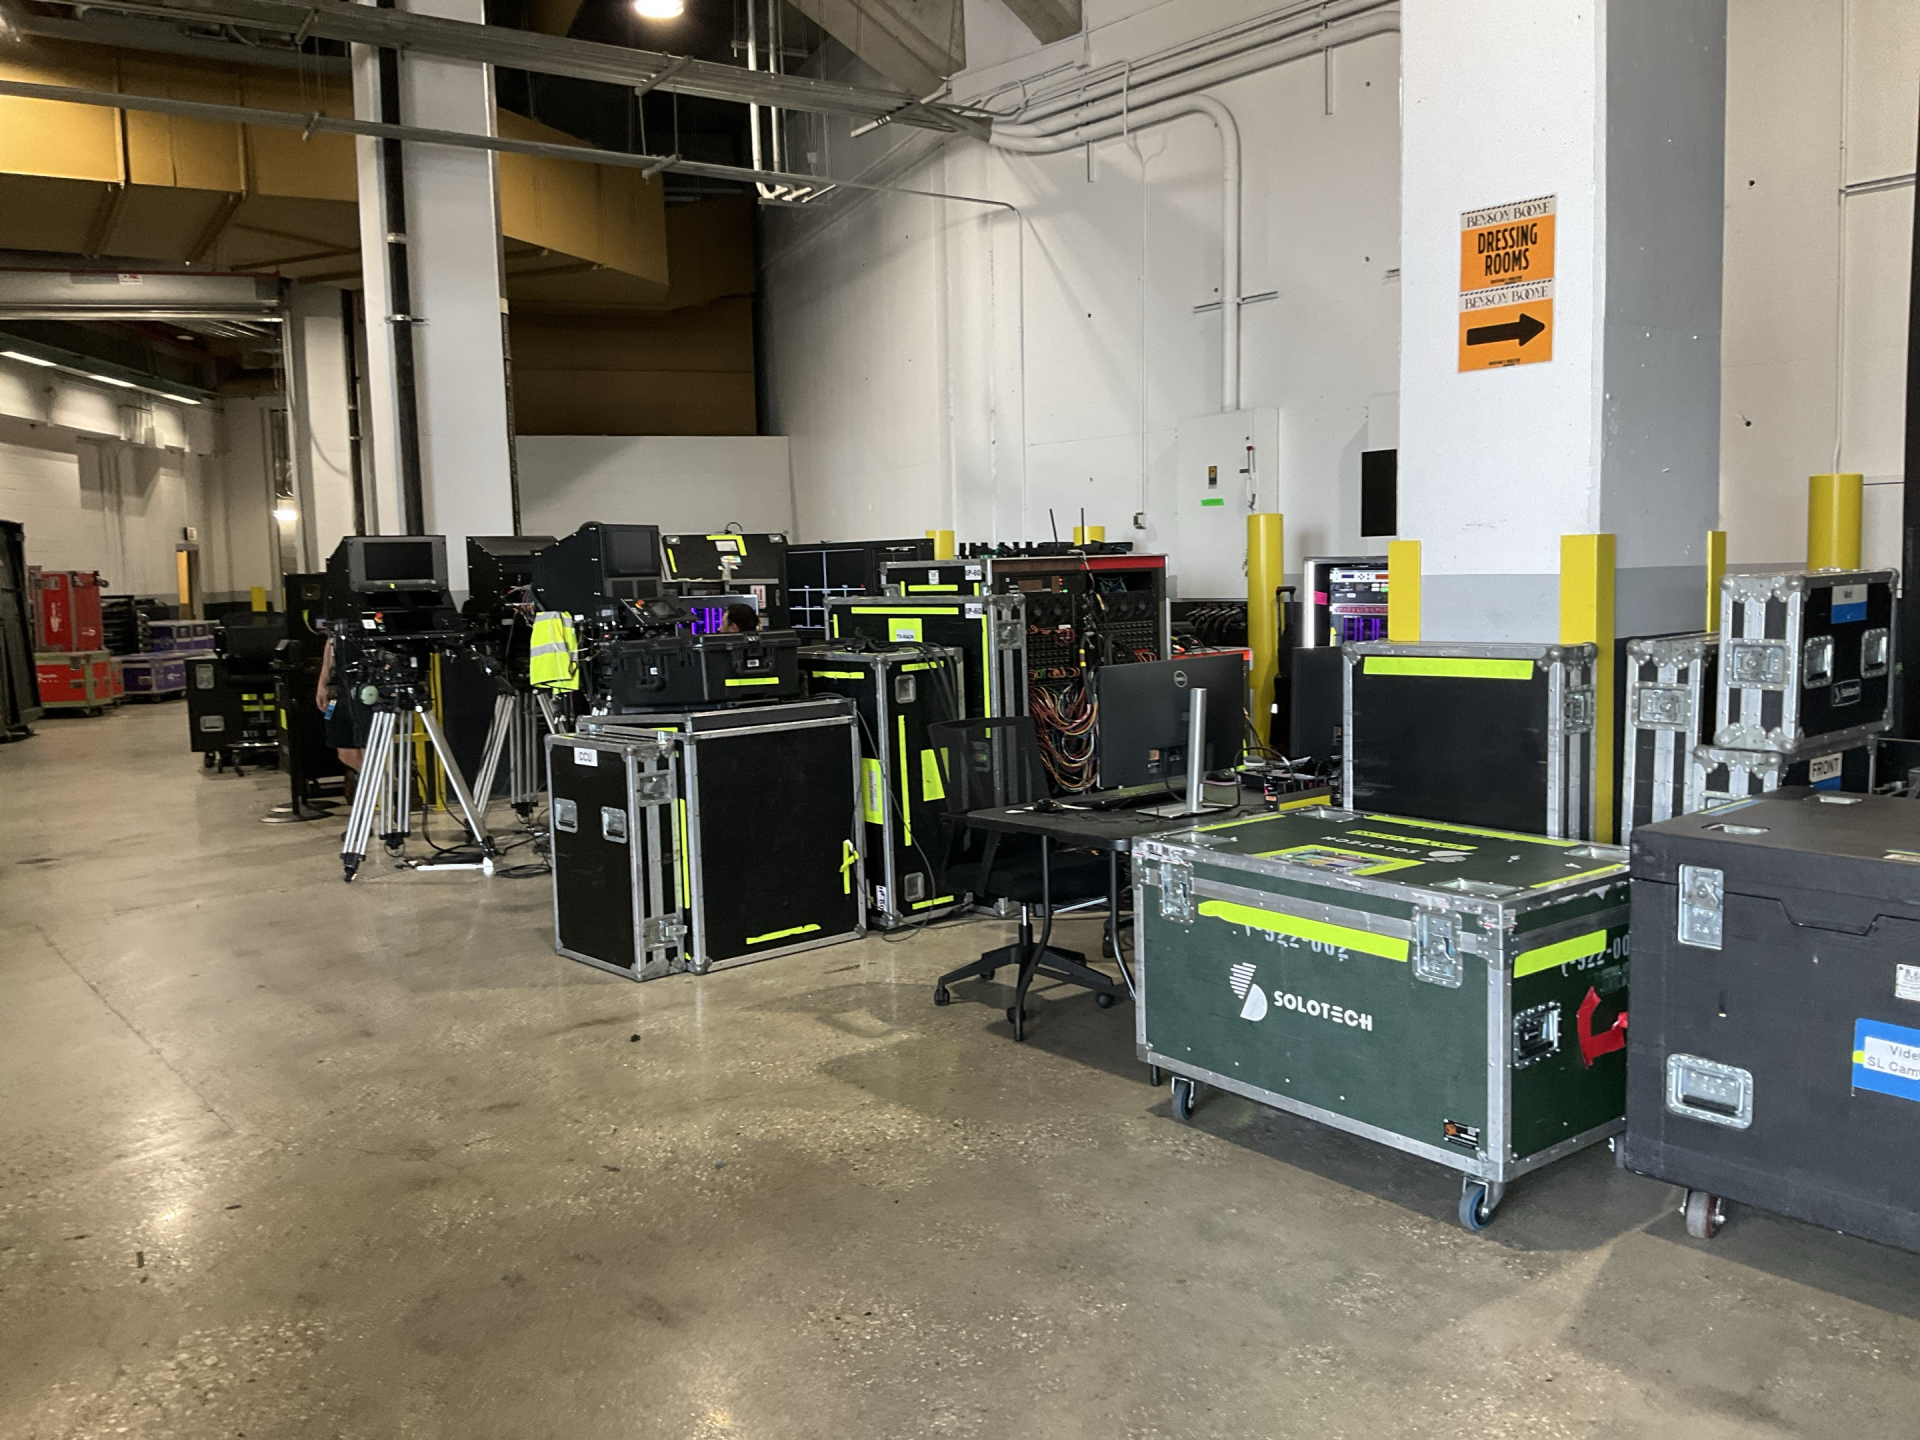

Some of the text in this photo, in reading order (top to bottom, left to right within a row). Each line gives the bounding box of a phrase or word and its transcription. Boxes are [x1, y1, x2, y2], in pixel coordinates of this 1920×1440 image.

[1466, 201, 1551, 229] BENSON BOONE
[1477, 222, 1538, 255] DRESSING
[1484, 247, 1530, 277] ROOMS
[1464, 285, 1549, 310] BENSON BOONE
[1812, 757, 1840, 780] FRONT
[1273, 990, 1373, 1032] SOLOTECH
[1867, 1056, 1920, 1078] SL Cam
